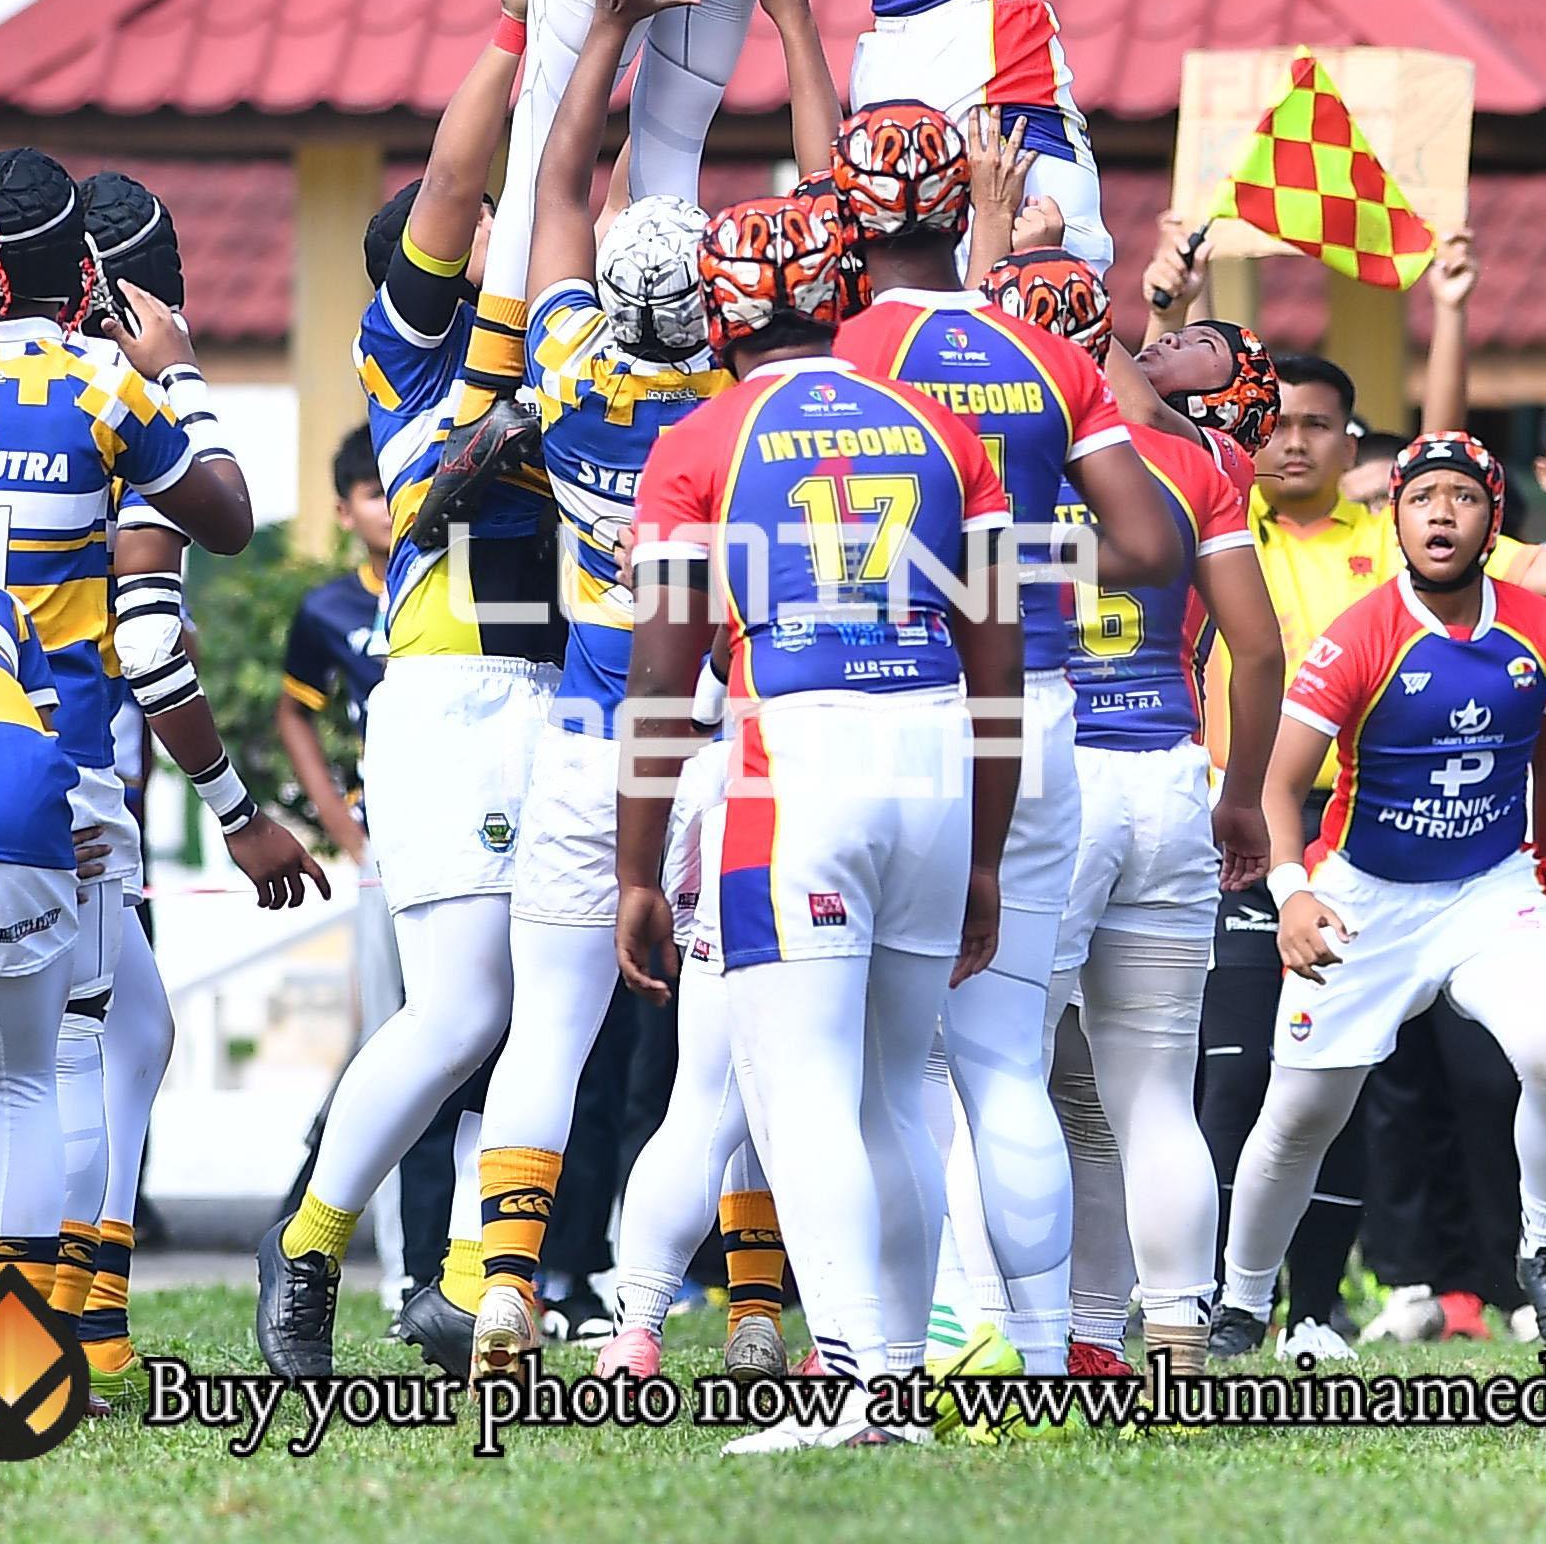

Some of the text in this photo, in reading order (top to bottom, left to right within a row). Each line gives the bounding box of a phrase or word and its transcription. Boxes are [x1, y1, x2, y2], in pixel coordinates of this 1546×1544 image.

[913, 381, 1045, 415] NTEGOMB
[757, 426, 928, 464] INTEGOMB
[787, 473, 922, 586] 17
[1073, 578, 1145, 659] 6
[1412, 794, 1496, 821] KLINIK
